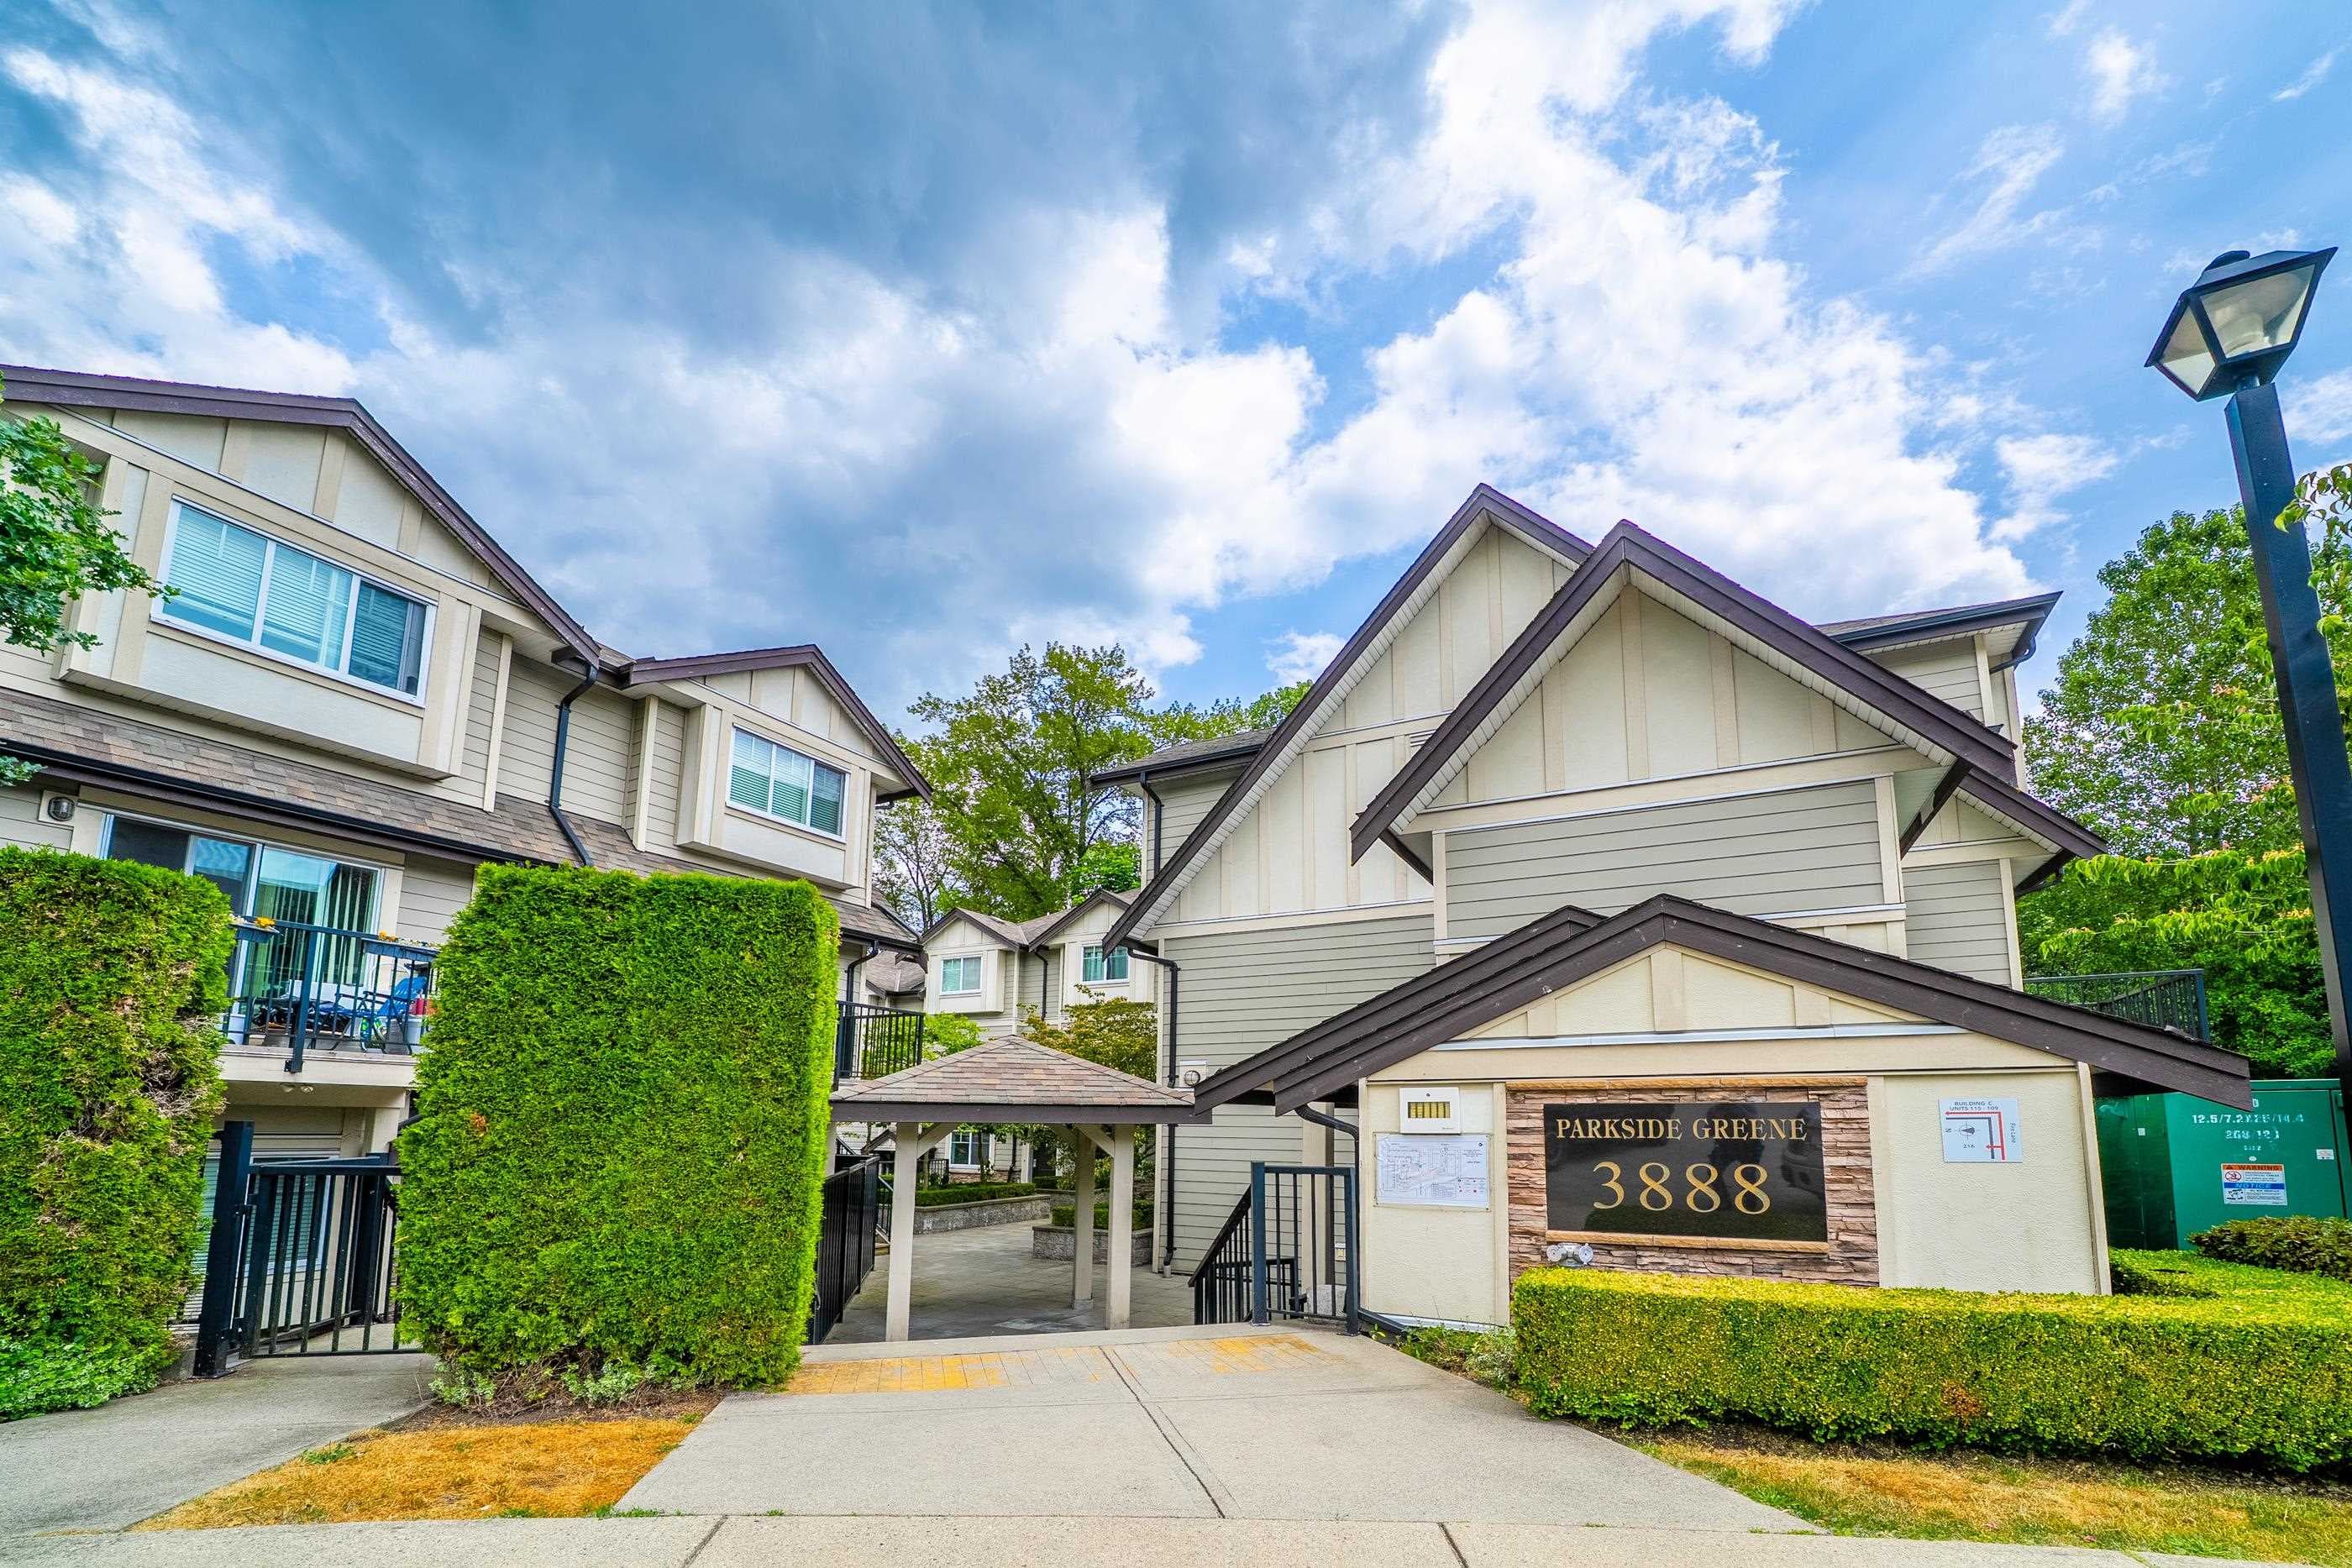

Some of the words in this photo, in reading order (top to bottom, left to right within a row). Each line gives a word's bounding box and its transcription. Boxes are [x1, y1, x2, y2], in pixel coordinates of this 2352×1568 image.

[1556, 1118, 1682, 1141] PARKSIDE
[1693, 1118, 1808, 1141] GREENE
[1593, 1161, 1771, 1215] 3888
